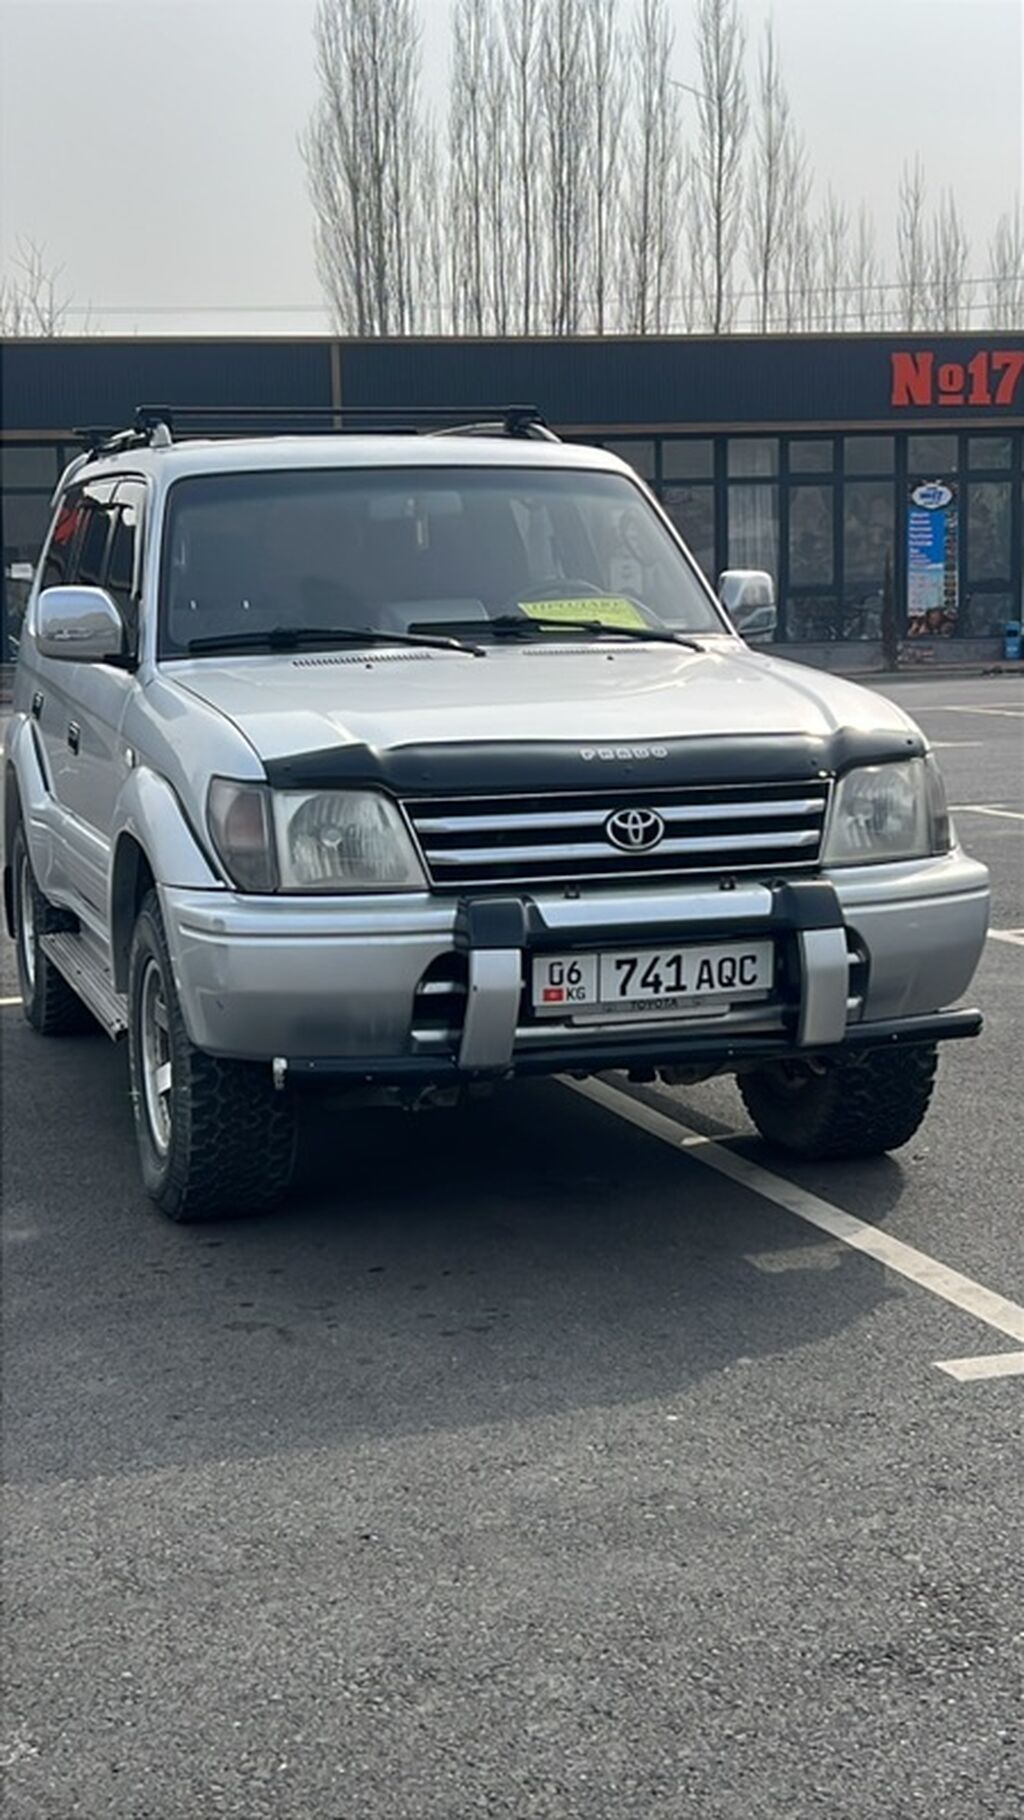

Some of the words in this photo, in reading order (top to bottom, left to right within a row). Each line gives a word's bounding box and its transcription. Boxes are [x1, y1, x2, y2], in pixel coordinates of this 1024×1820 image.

[580, 745, 668, 760] PRADO
[549, 961, 581, 986] 06
[615, 955, 687, 996] 741
[696, 955, 757, 990] AQC
[566, 987, 586, 1001] KG
[631, 998, 679, 1010] TOYOTA
